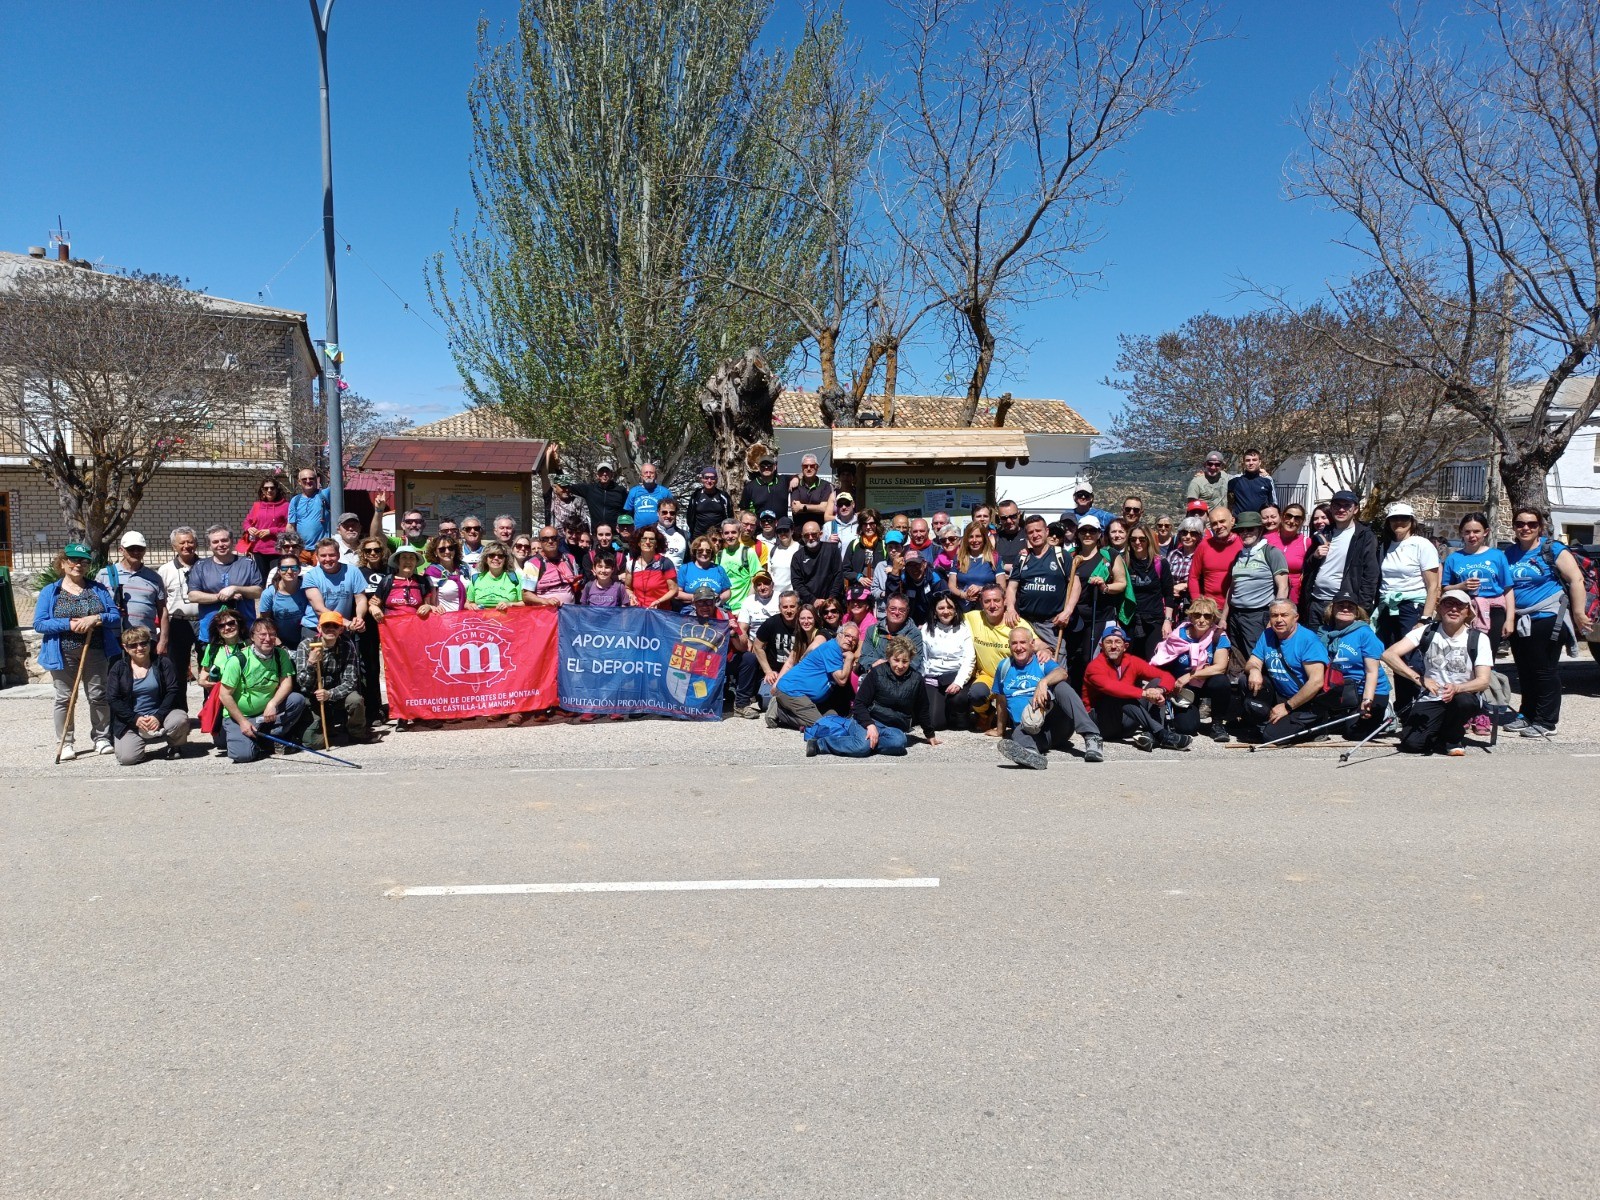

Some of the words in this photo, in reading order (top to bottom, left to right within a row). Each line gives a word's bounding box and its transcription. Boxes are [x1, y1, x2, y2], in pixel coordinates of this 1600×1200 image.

[895, 477, 944, 485] SENDERISTAS
[1023, 583, 1056, 592] Emirates
[455, 631, 495, 643] FDMCM
[572, 634, 661, 651] APOYANDO
[974, 636, 1004, 648] Bienvenidos
[567, 658, 585, 673] EL
[592, 660, 662, 677] DEPORTE
[405, 696, 449, 707] FEDERACIÓN
[462, 694, 493, 703] DEPORTES
[494, 692, 506, 700] DE
[508, 689, 540, 698] MONTAÑA
[443, 701, 487, 711] CASTILLA-LA
[488, 699, 516, 708] MANCHA
[562, 696, 615, 707] DIPUTACIÓN
[617, 698, 665, 708] PROVINCIAL
[667, 702, 677, 710] DE
[679, 705, 715, 715] CUENCA
